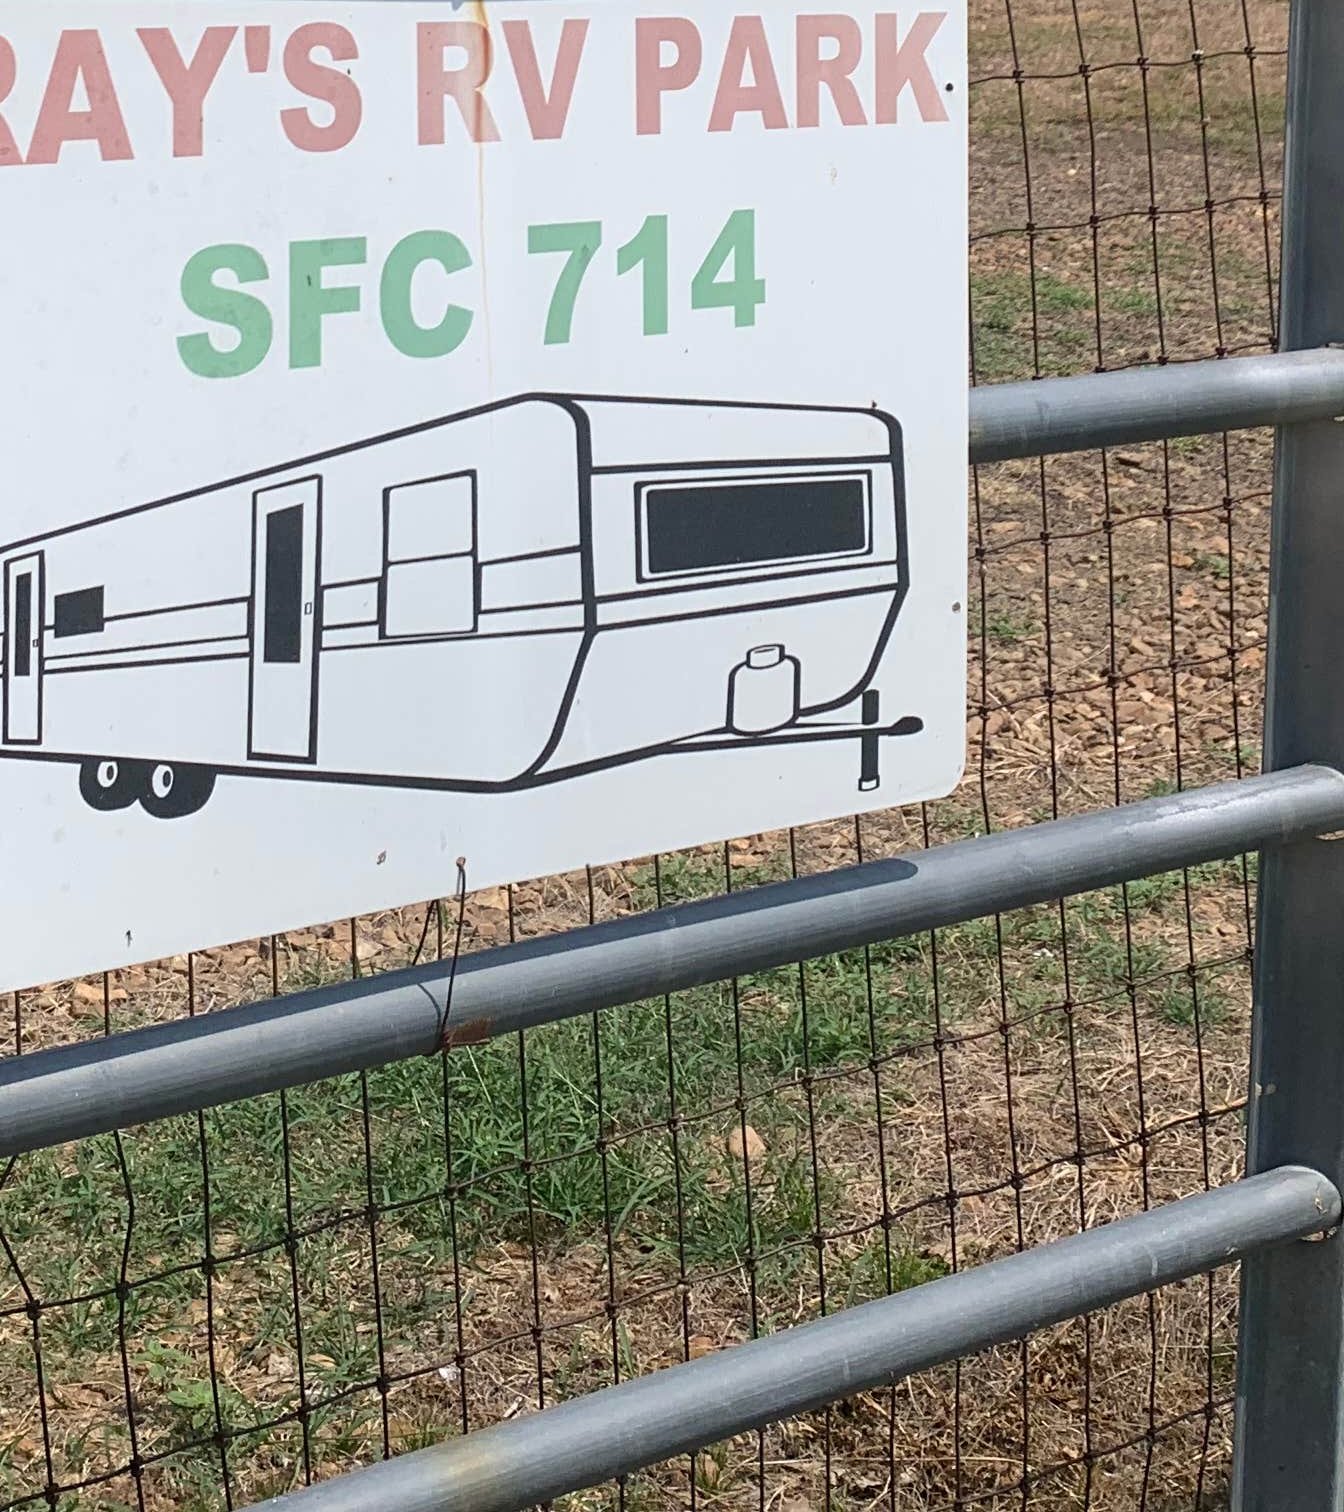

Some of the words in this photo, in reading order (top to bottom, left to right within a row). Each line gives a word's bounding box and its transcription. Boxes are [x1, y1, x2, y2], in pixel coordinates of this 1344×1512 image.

[416, 18, 587, 145] RV
[636, 12, 948, 136] PARK
[178, 231, 473, 378] SFC
[528, 209, 766, 345] 714
